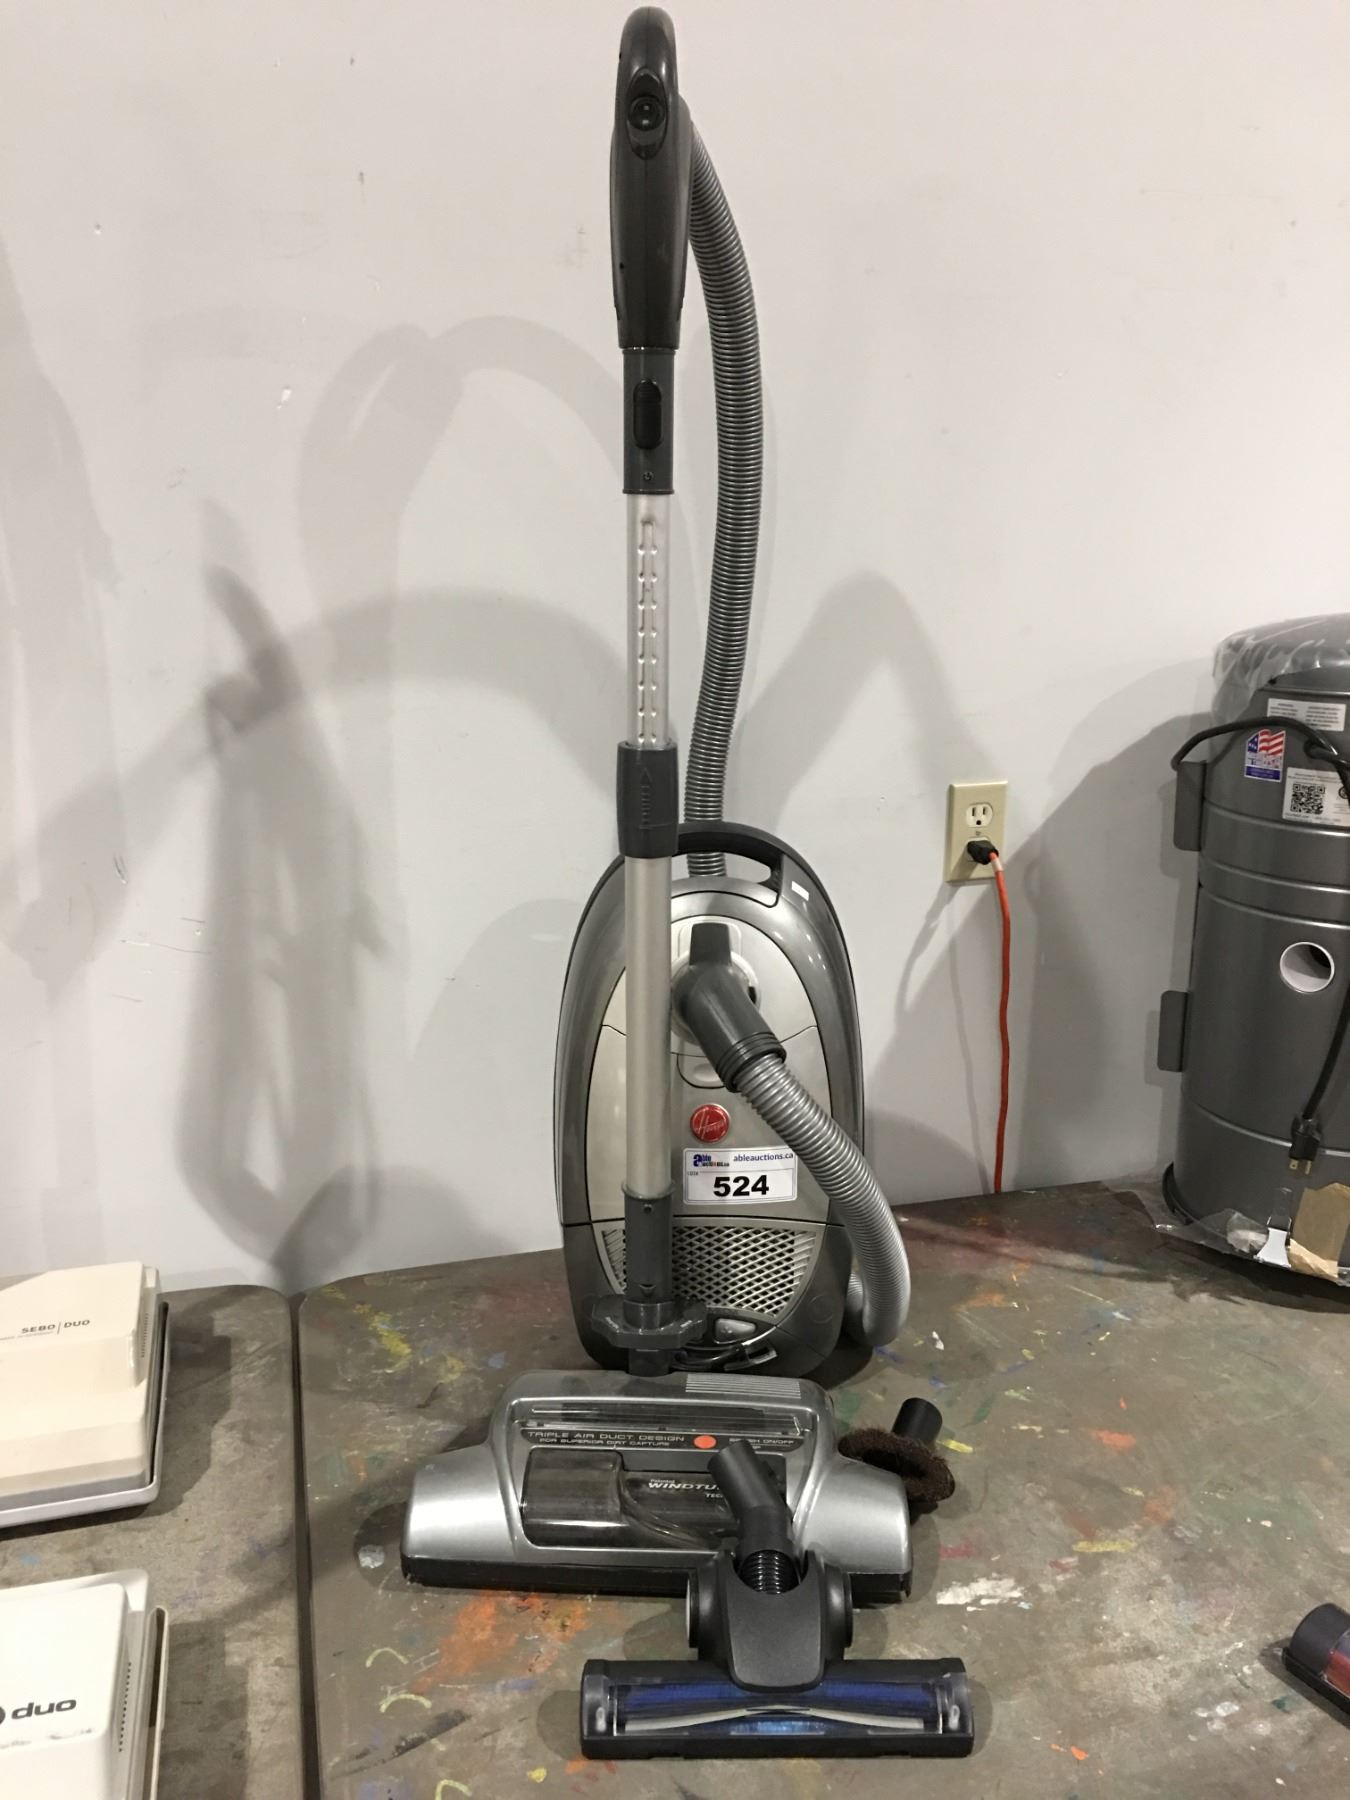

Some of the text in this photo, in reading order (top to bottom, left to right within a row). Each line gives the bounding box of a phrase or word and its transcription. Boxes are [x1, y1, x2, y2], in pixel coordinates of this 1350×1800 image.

[734, 1152, 793, 1162] ableauctions.ca
[713, 1174, 769, 1197] 524
[21, 1319, 90, 1333] SEBO DUO
[638, 1434, 685, 1442] DESIGN
[648, 1482, 720, 1490] WINDTU
[11, 1699, 77, 1719] duo
